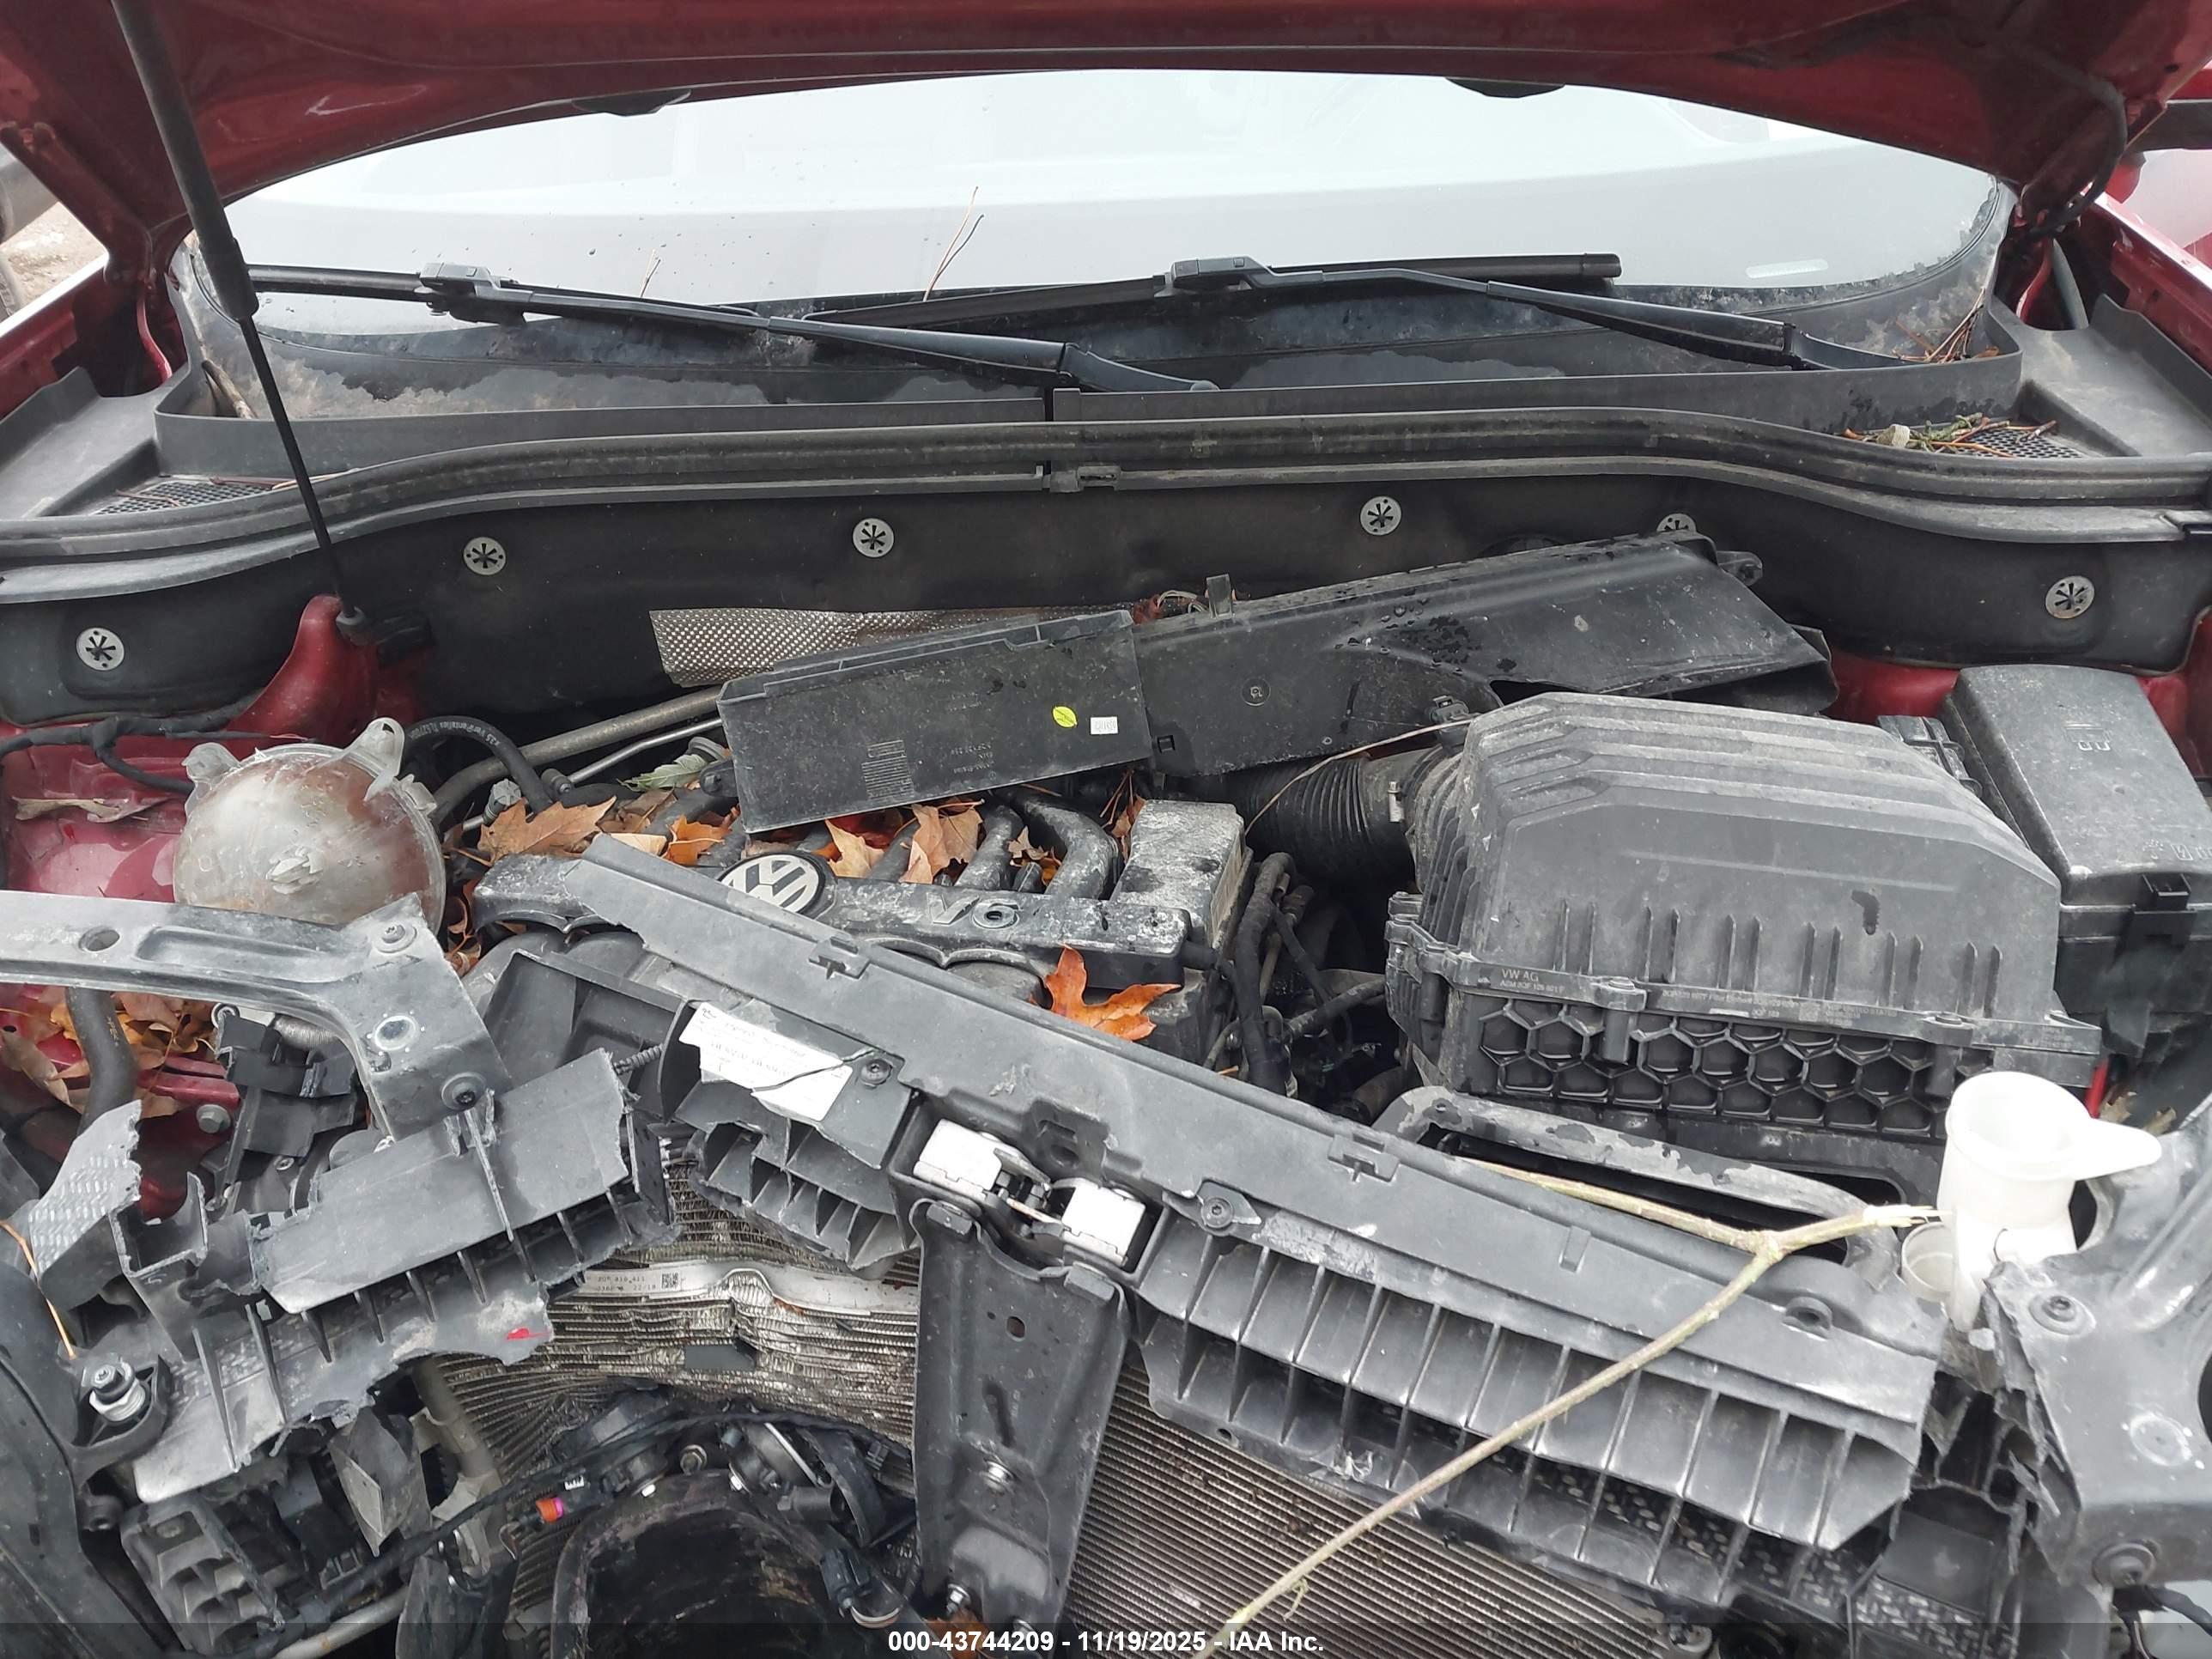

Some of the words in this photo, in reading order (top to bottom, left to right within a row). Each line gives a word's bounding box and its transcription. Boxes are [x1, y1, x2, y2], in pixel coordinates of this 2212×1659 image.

[926, 892, 1022, 930] V6
[1500, 968, 1520, 981] VW
[1523, 970, 1540, 982] AG
